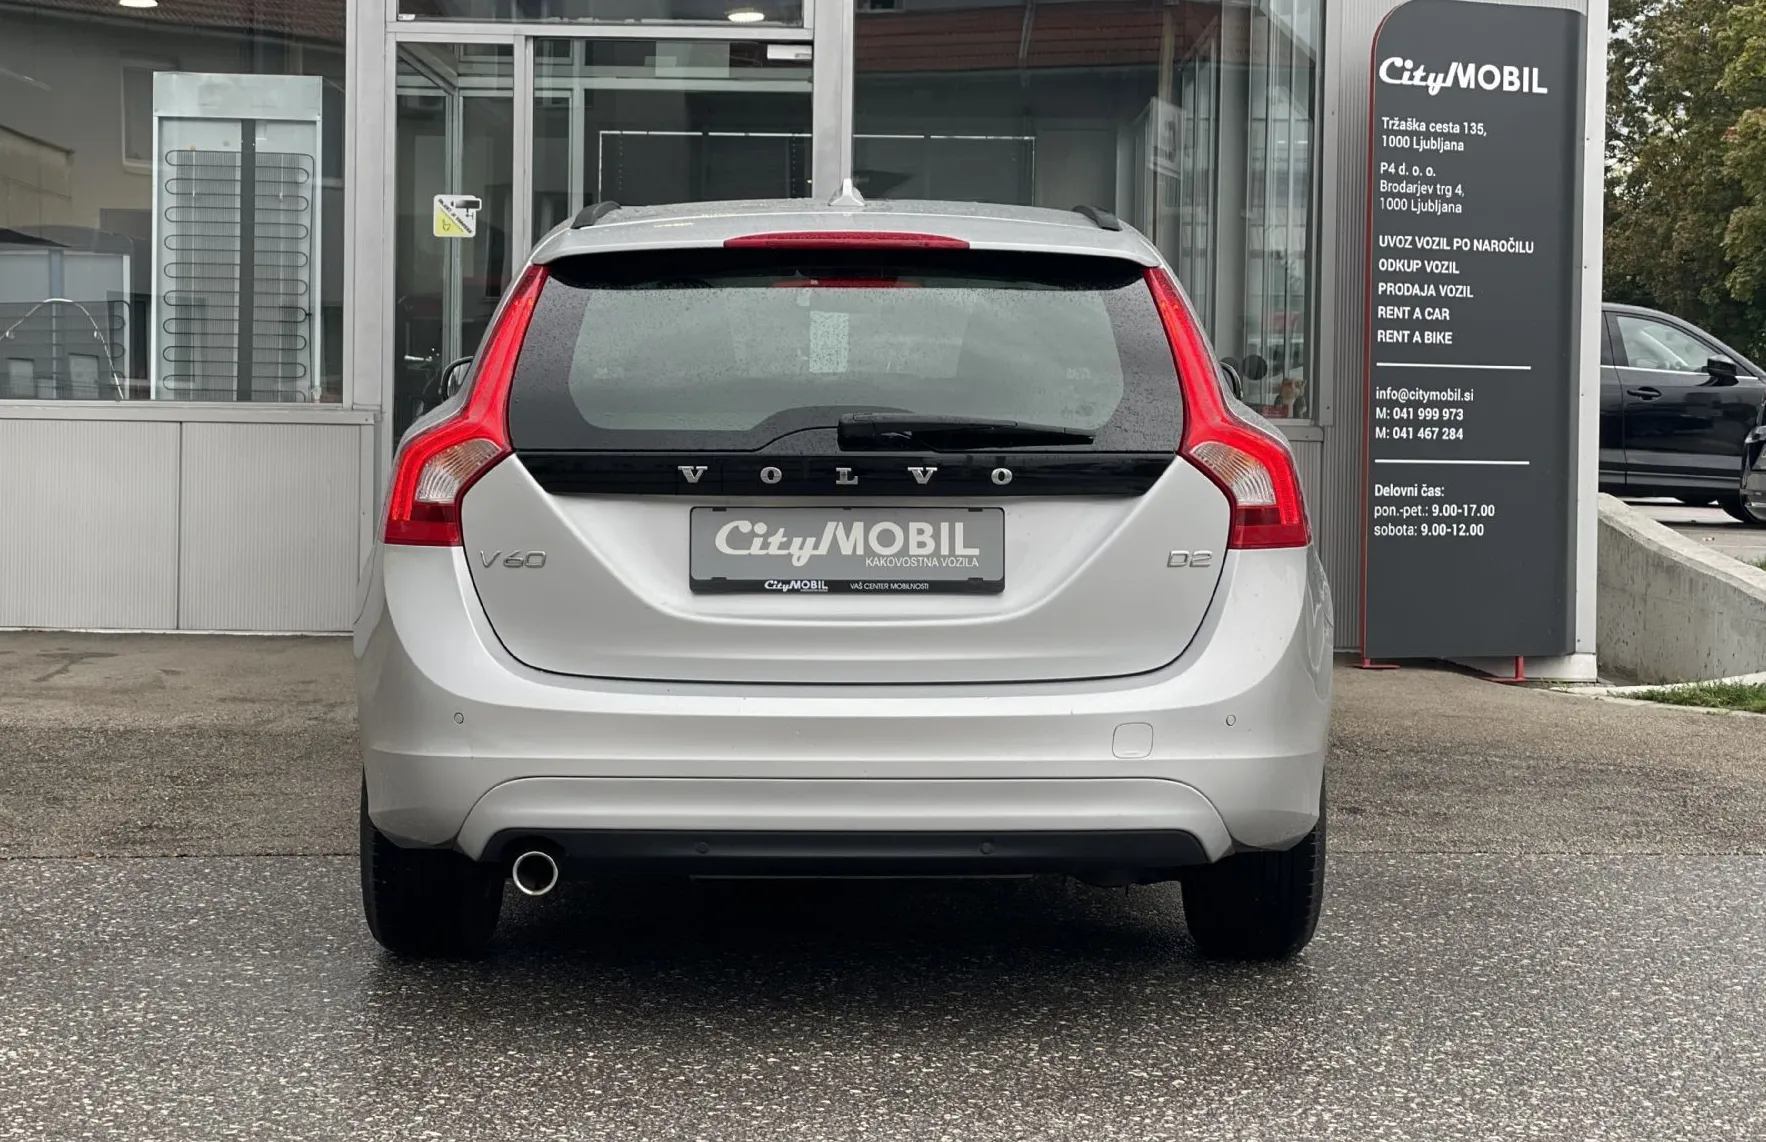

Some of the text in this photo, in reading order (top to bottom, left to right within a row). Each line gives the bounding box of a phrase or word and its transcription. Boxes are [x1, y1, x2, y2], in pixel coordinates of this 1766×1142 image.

[1382, 117, 1487, 136] Tržaška cesta 135,
[1382, 135, 1464, 153] 1000 Ljubljana
[1380, 162, 1436, 176] P4 d. o. o.
[1380, 180, 1464, 197] Brodarjev trg 4,
[1380, 198, 1462, 215] 1000 Ljubljana
[1379, 235, 1534, 254] UVOZ VOZIL PO NAROČILU
[1379, 259, 1460, 274] ODKUP VOZIL
[1379, 283, 1473, 298] PRODAJA VOZIL
[1378, 306, 1450, 320] RENT A CAR
[1377, 330, 1452, 344] RENT A BIKE
[1376, 387, 1474, 403] info@citymobil.si
[1376, 407, 1464, 420] M: 041 999 973
[1375, 427, 1463, 440] M: 041 467 284
[678, 466, 1013, 485] VOLVO
[1375, 484, 1445, 497] Delovni čas:
[1374, 504, 1495, 518] pon.-pet.: 9.00-17.00
[1374, 523, 1484, 536] sobota: 9.00-12.00
[479, 549, 547, 568] V60
[865, 557, 979, 567] KAKOVOSTNA VOZILA
[1166, 549, 1213, 568] D2
